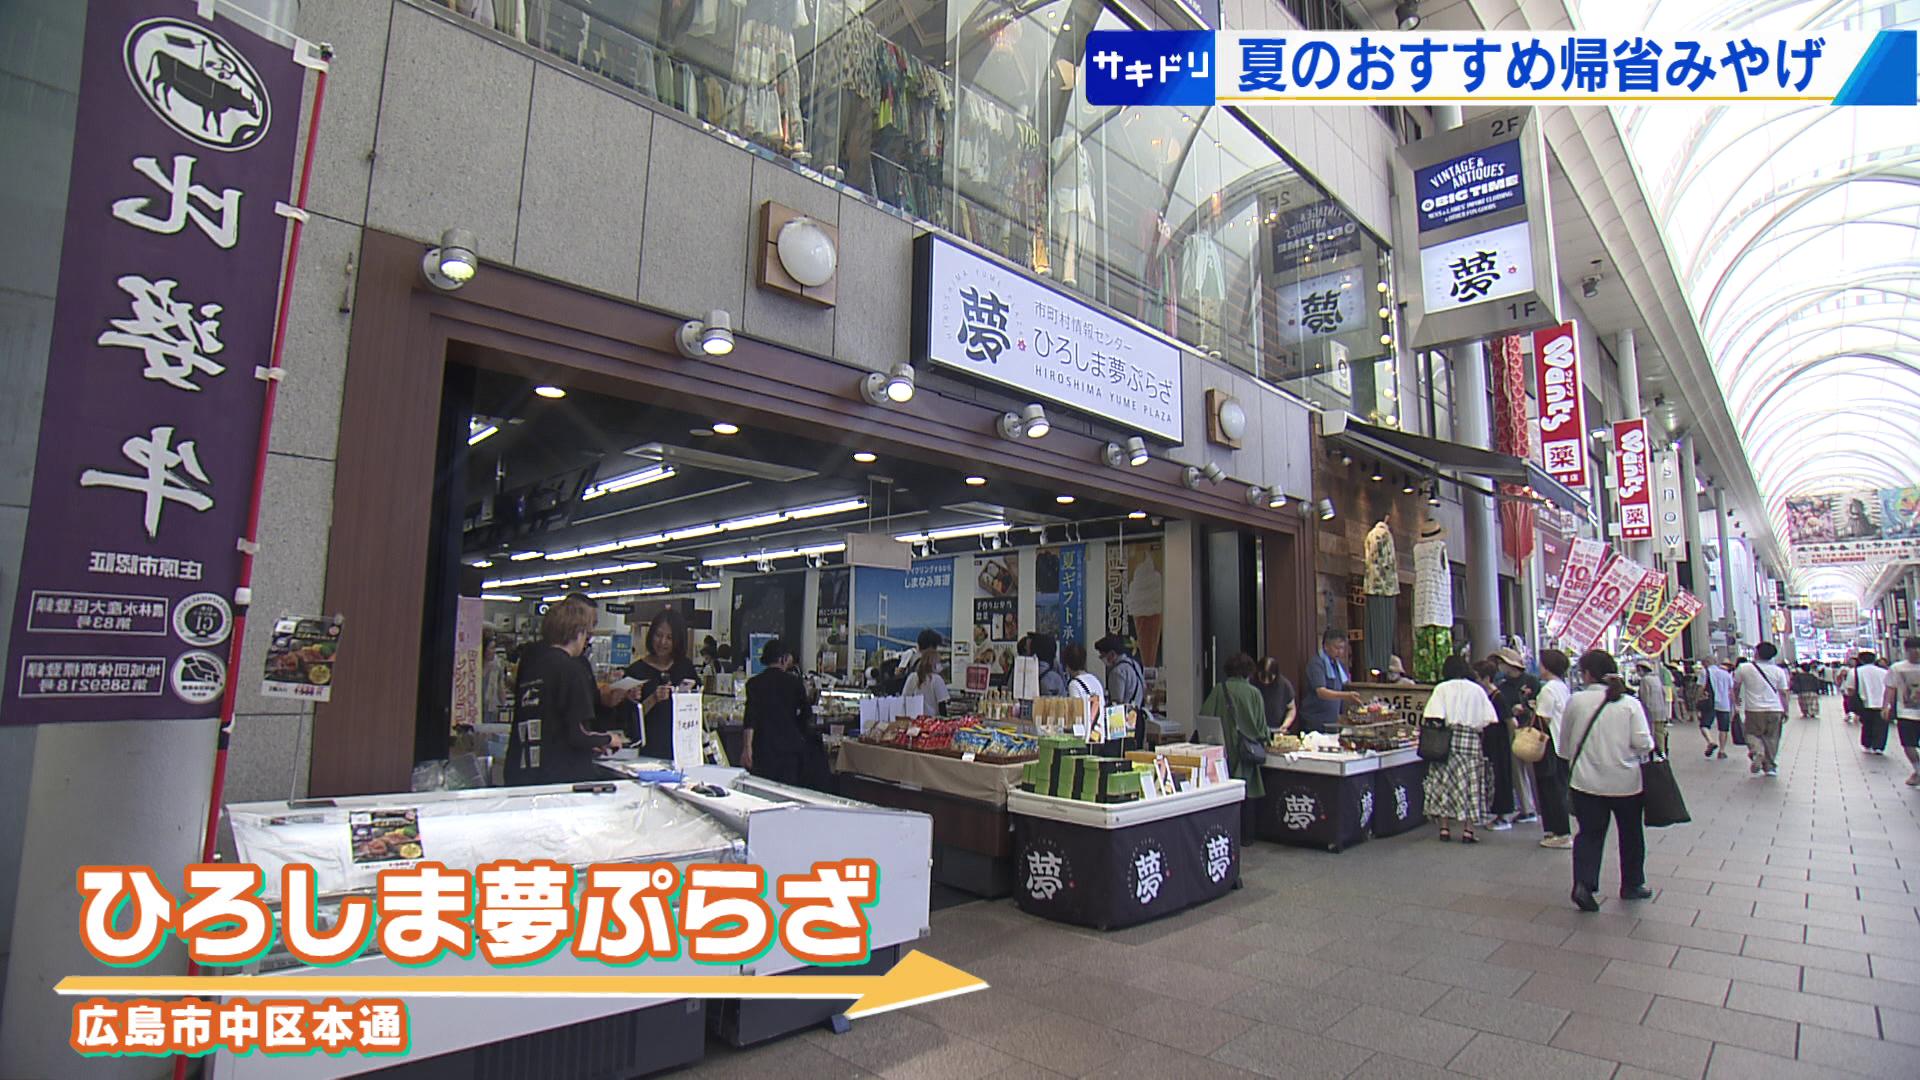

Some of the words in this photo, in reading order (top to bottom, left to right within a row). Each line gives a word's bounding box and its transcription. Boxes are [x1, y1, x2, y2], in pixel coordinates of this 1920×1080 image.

[1491, 116, 1519, 137] 2F
[1430, 157, 1476, 188] VINTAGE
[1435, 188, 1469, 207] BIG
[1469, 174, 1519, 197] TIME
[1452, 163, 1506, 189] ANTIQUES
[1449, 250, 1501, 302] 夢
[958, 286, 1011, 364] 夢
[1034, 301, 1132, 351] 市町村情報センター
[1507, 301, 1537, 320] 1F
[1034, 328, 1173, 406] ひろしま夢ぷらざ
[1540, 335, 1575, 432] Wants
[1035, 364, 1102, 398] HIROSHIMA
[1109, 393, 1138, 411] YUME
[1143, 405, 1172, 423] PLAZA
[1550, 445, 1575, 468] 薬
[1619, 429, 1645, 498] Wants
[1564, 579, 1589, 593] OFF
[1590, 596, 1615, 613] OFF
[1283, 794, 1316, 830] 夢
[1026, 851, 1063, 900] 夢
[1135, 850, 1163, 904] 夢
[1206, 834, 1231, 883] 夢
